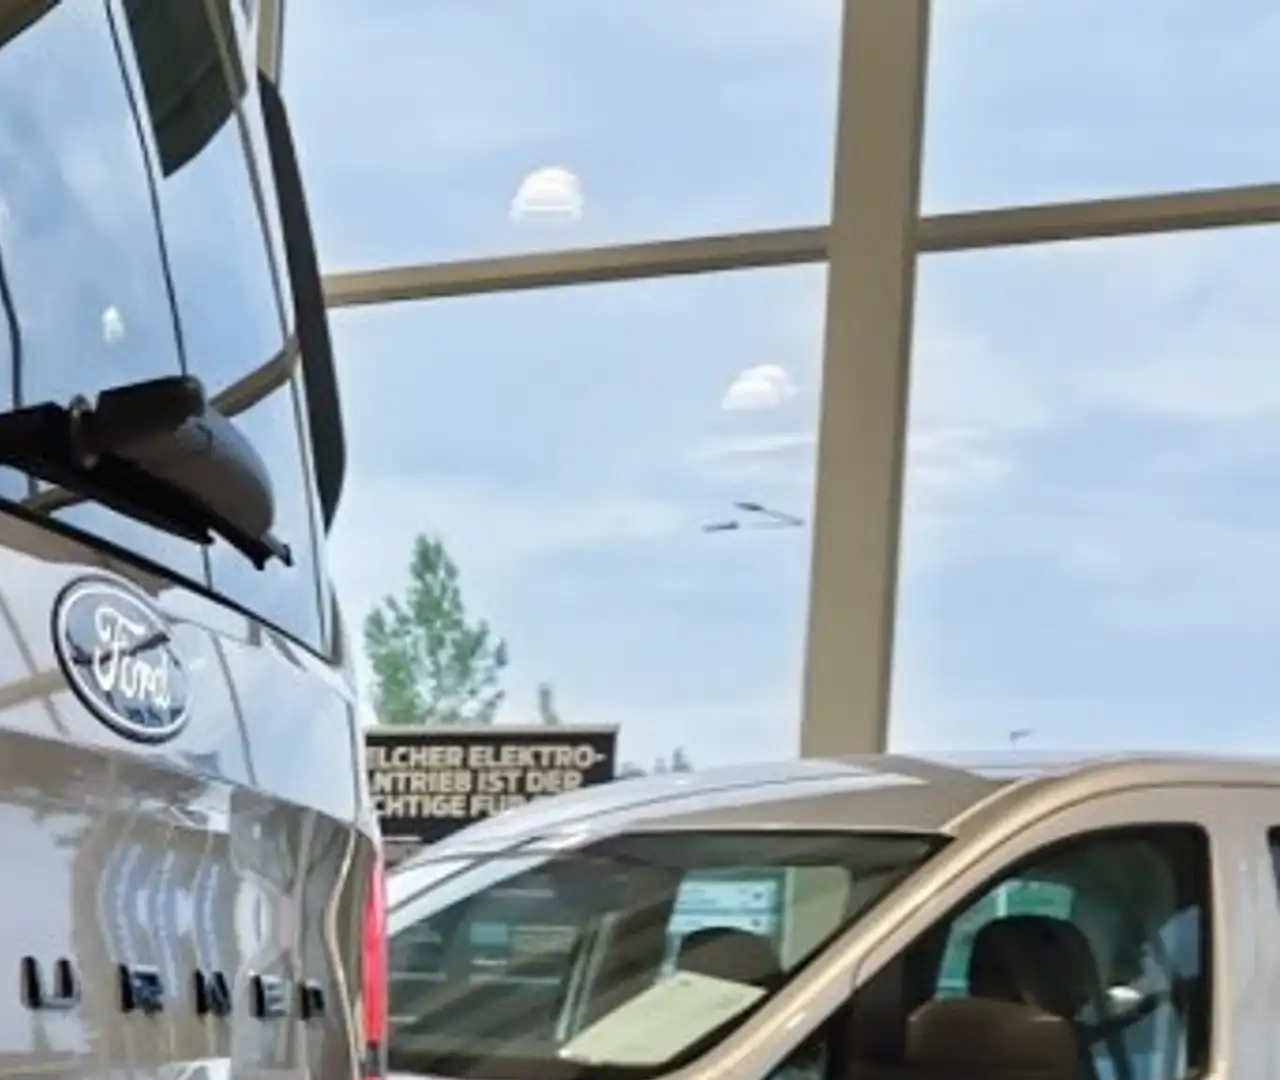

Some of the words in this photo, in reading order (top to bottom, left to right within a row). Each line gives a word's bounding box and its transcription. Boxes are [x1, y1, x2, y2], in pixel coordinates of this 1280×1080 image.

[93, 607, 170, 706] Ford
[469, 745, 607, 769] ELEKTRO-
[370, 770, 472, 793] NTRIEB
[477, 770, 521, 793] IST
